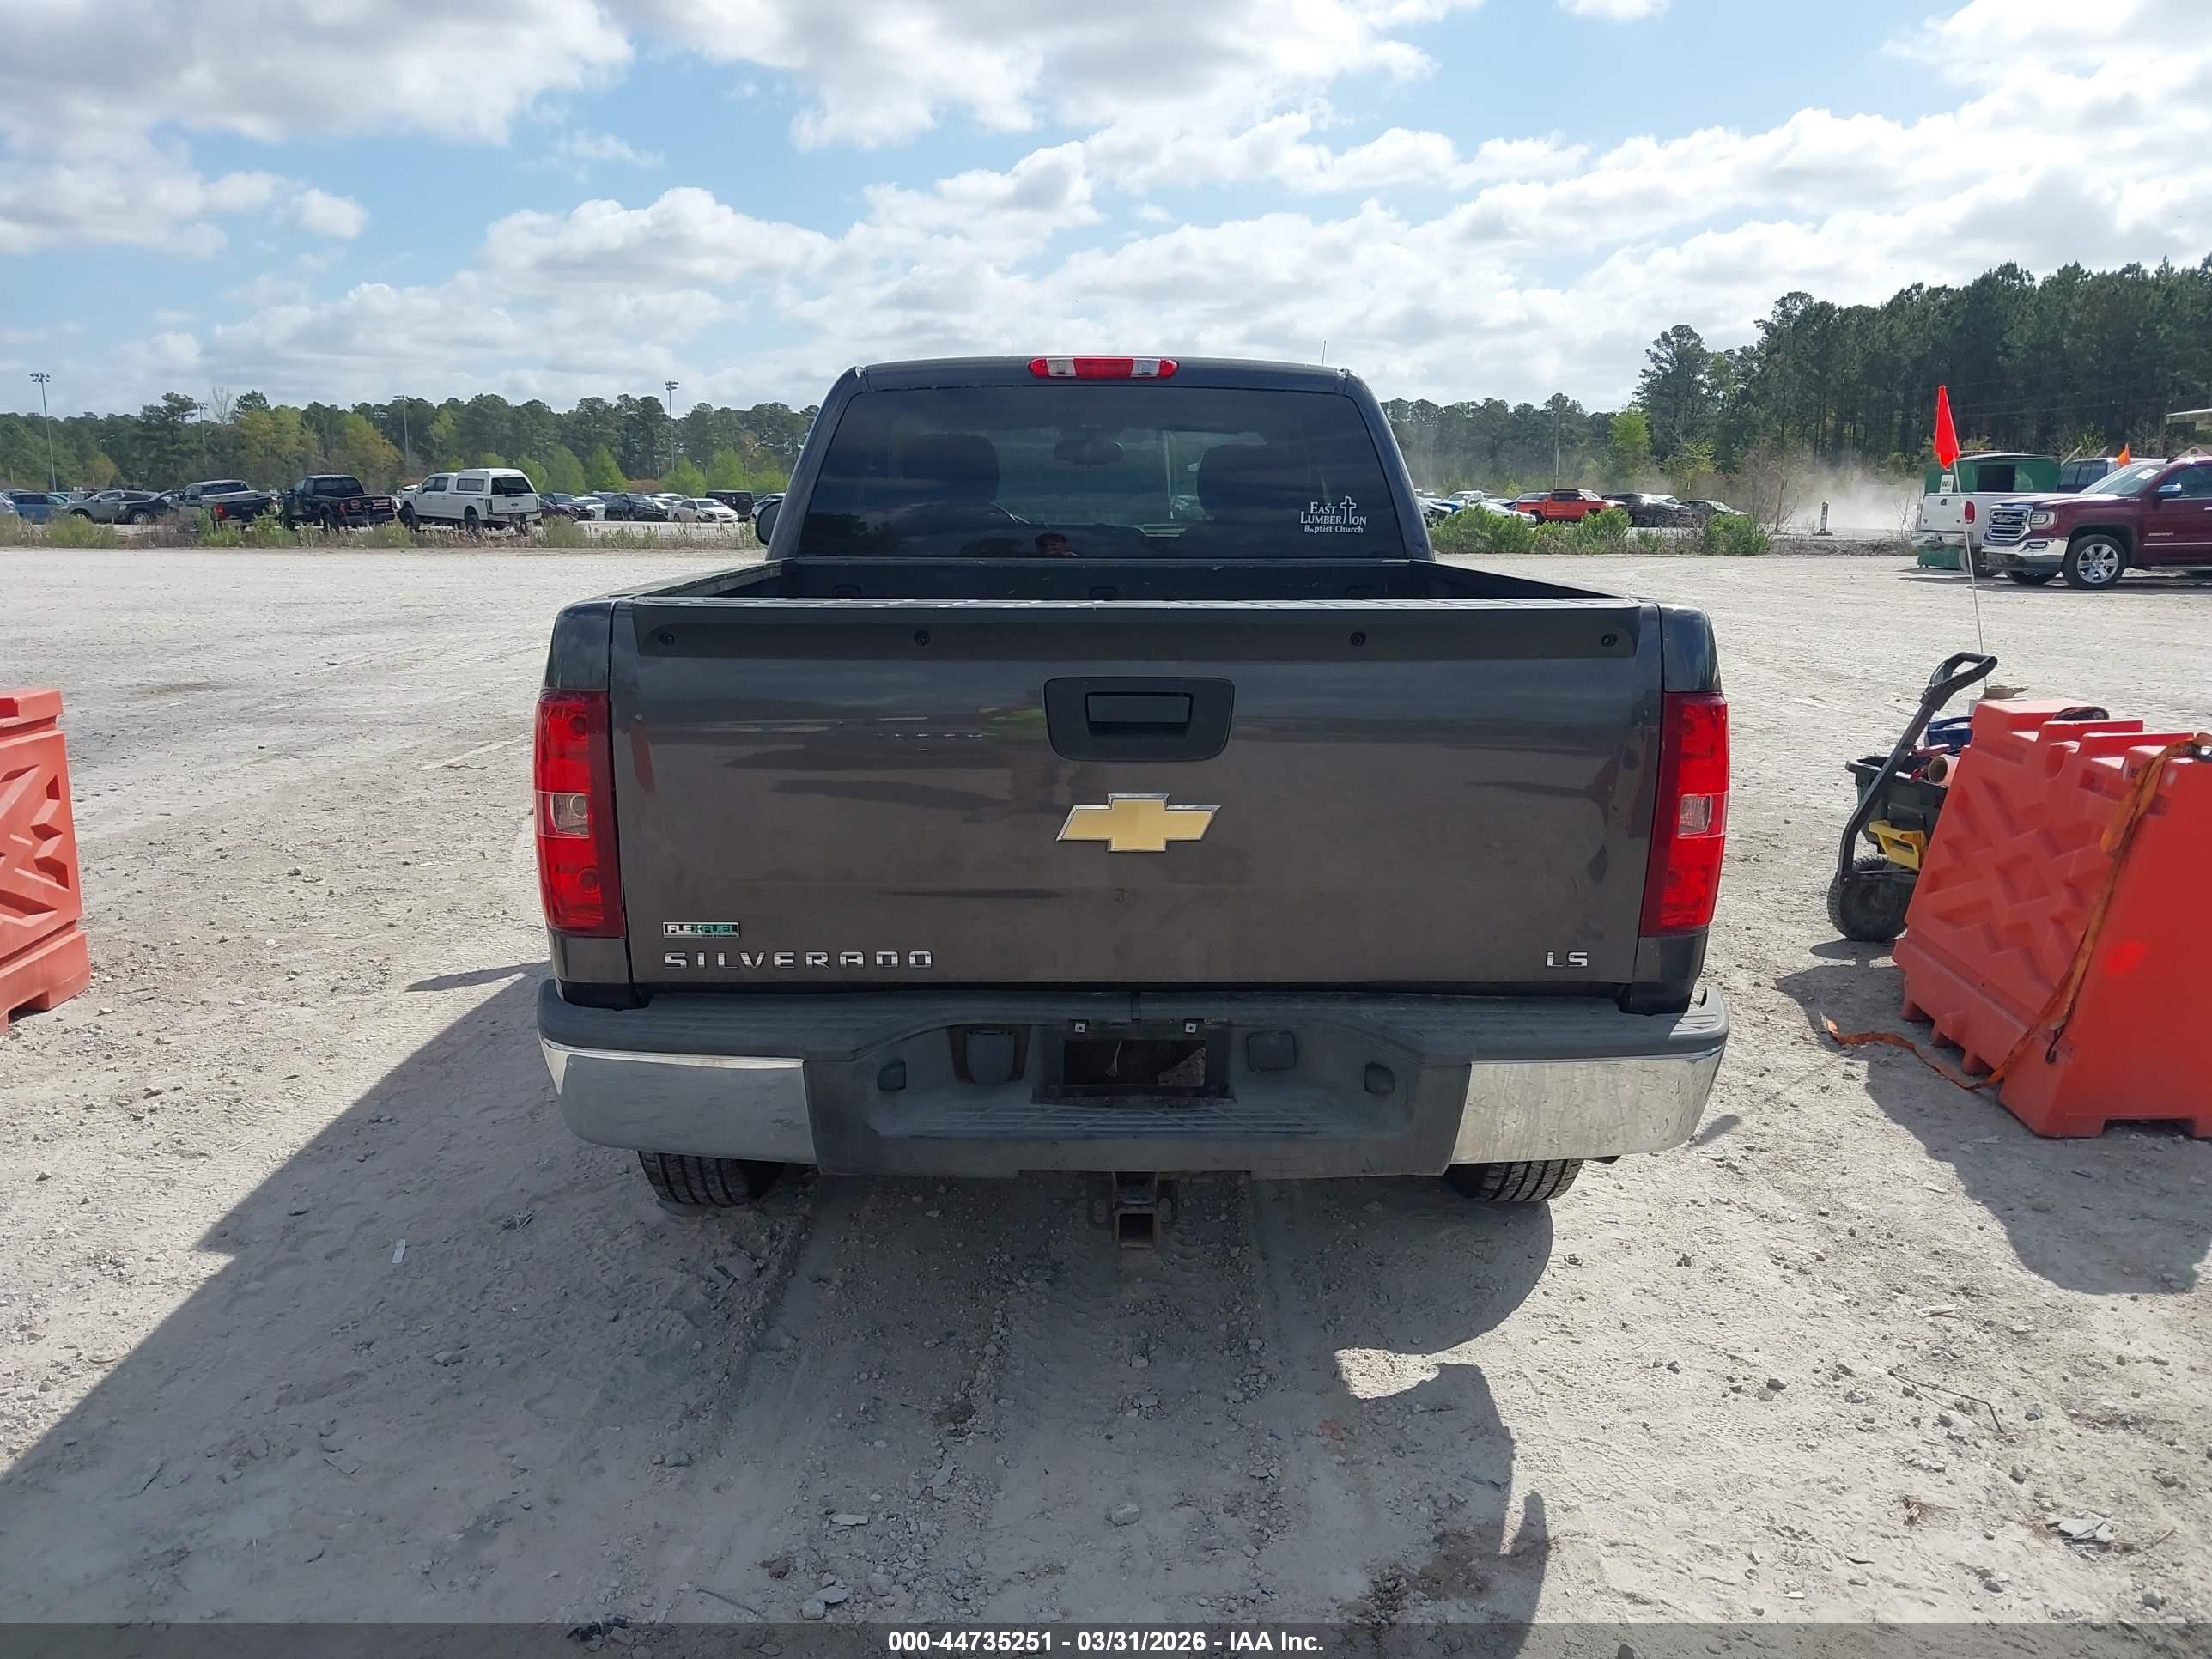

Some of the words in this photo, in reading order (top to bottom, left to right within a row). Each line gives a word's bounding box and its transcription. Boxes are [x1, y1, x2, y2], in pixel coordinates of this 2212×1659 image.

[1310, 501, 1337, 514] EAST
[664, 951, 932, 969] SILVERADO
[1547, 951, 1588, 967] LS
